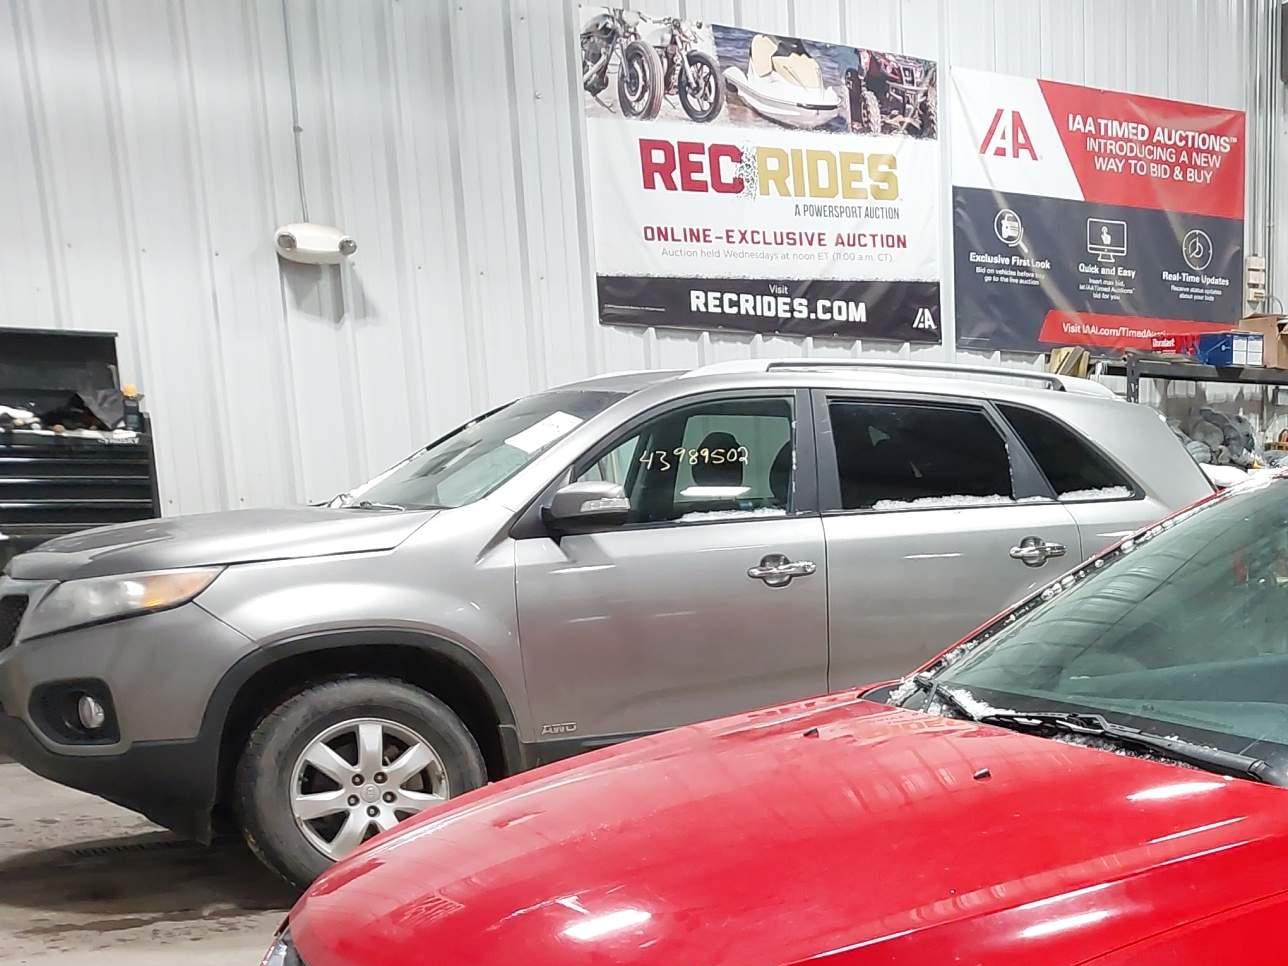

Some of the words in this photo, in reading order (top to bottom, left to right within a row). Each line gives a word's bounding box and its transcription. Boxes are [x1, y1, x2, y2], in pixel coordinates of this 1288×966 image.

[1068, 113, 1096, 134] IAA
[1098, 118, 1149, 142] TIMED
[1086, 137, 1176, 163] INTRODUCING
[1179, 150, 1188, 164] A
[1191, 152, 1222, 168] NEW
[639, 138, 745, 194] REC
[756, 146, 899, 200] RIDES
[1094, 156, 1125, 173] WAY
[1128, 160, 1147, 176] TO
[1151, 163, 1171, 179] BID
[1173, 166, 1183, 181] &
[1187, 169, 1213, 184] BUY
[794, 204, 801, 217] A
[803, 204, 862, 219] POWERSPORT
[864, 206, 900, 220] AUCTION
[643, 226, 827, 247] ONLINE-EXCLUSIVE
[834, 232, 907, 249] AUCTION
[661, 248, 698, 258] Auction
[700, 249, 721, 258] held
[723, 249, 779, 261] Wednesdays
[781, 252, 790, 260] at
[969, 252, 1010, 265] Exclusive
[1011, 256, 1031, 267] First
[1031, 258, 1051, 269] Look
[1079, 263, 1099, 274] Quick
[1100, 266, 1116, 275] and
[1117, 267, 1136, 279] Easy
[1162, 271, 1200, 283] Real-Time
[1201, 275, 1229, 286] Updates
[768, 284, 788, 295] Visit
[690, 290, 867, 322] RECRIDES.COM
[1063, 323, 1081, 333] Visit
[542, 722, 577, 735] AWD
